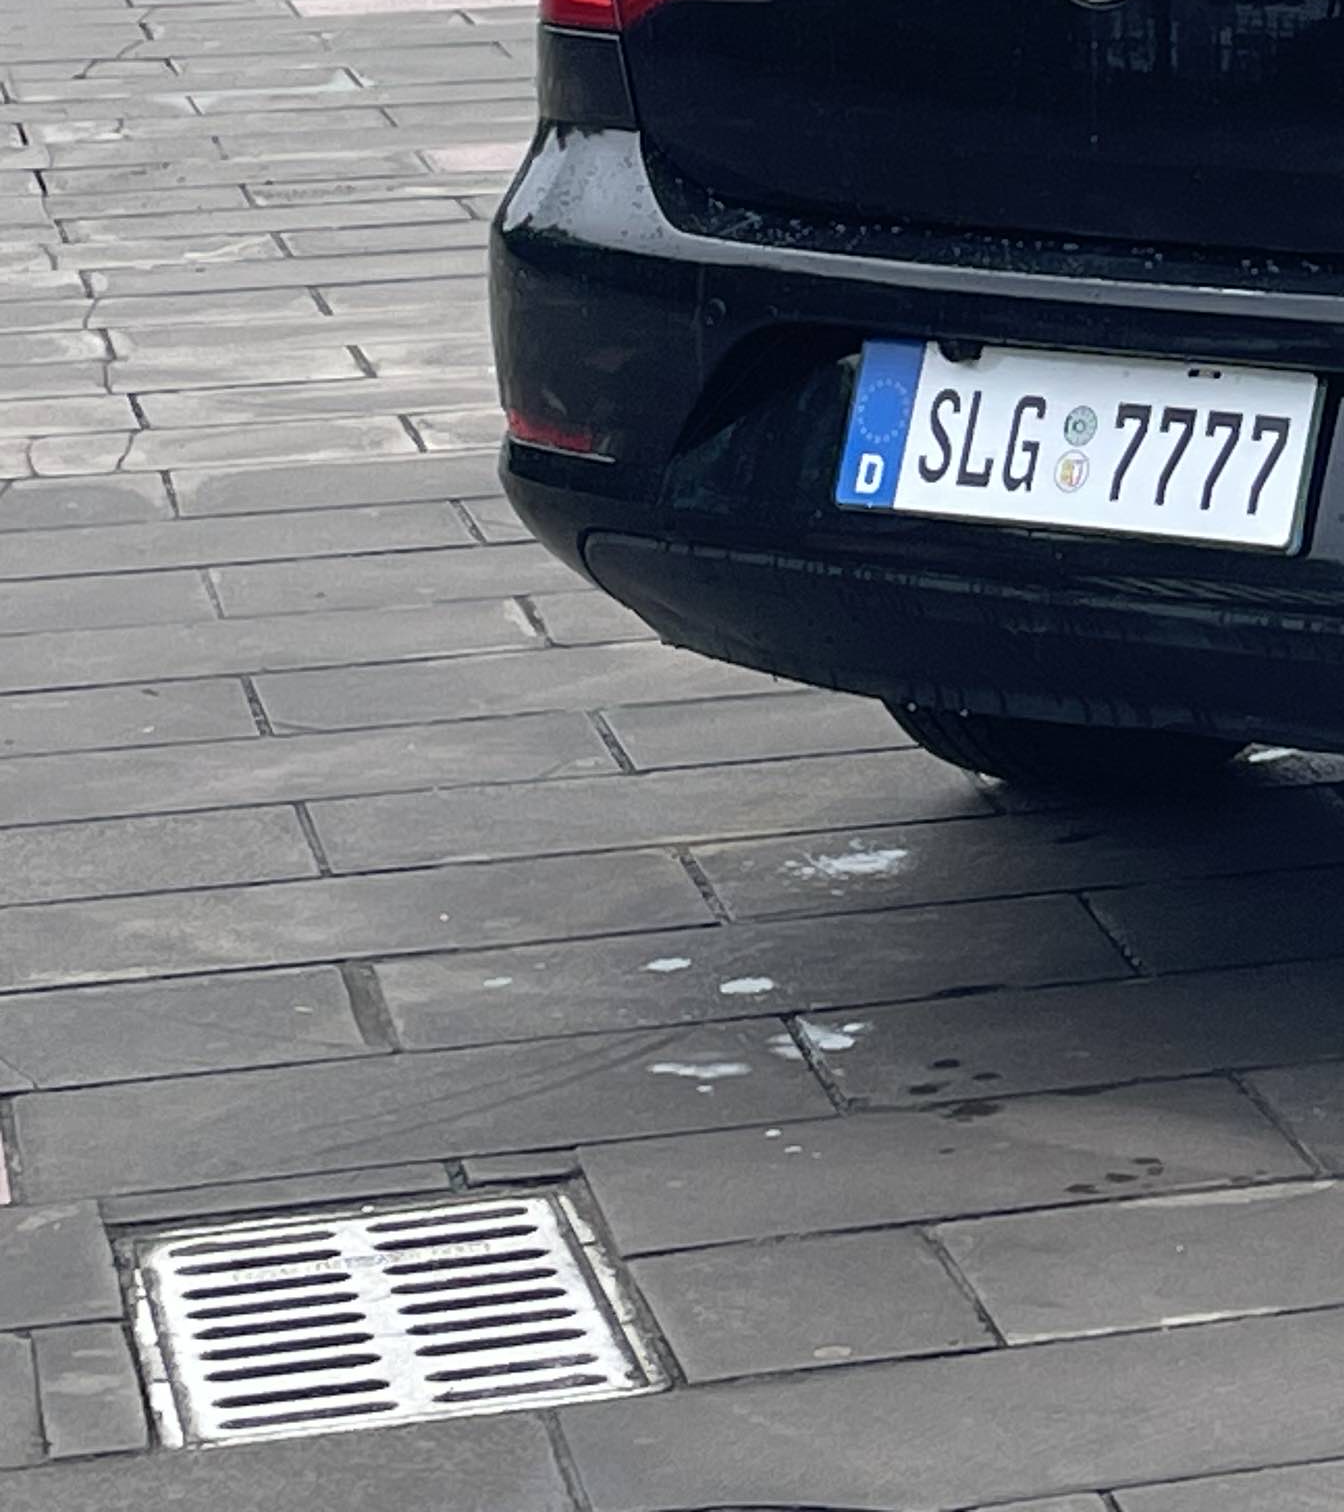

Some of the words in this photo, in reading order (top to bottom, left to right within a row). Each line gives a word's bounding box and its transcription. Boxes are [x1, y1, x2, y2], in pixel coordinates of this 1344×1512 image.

[856, 453, 884, 494] D
[918, 388, 1046, 492] SLG
[1109, 402, 1291, 515] 7777
